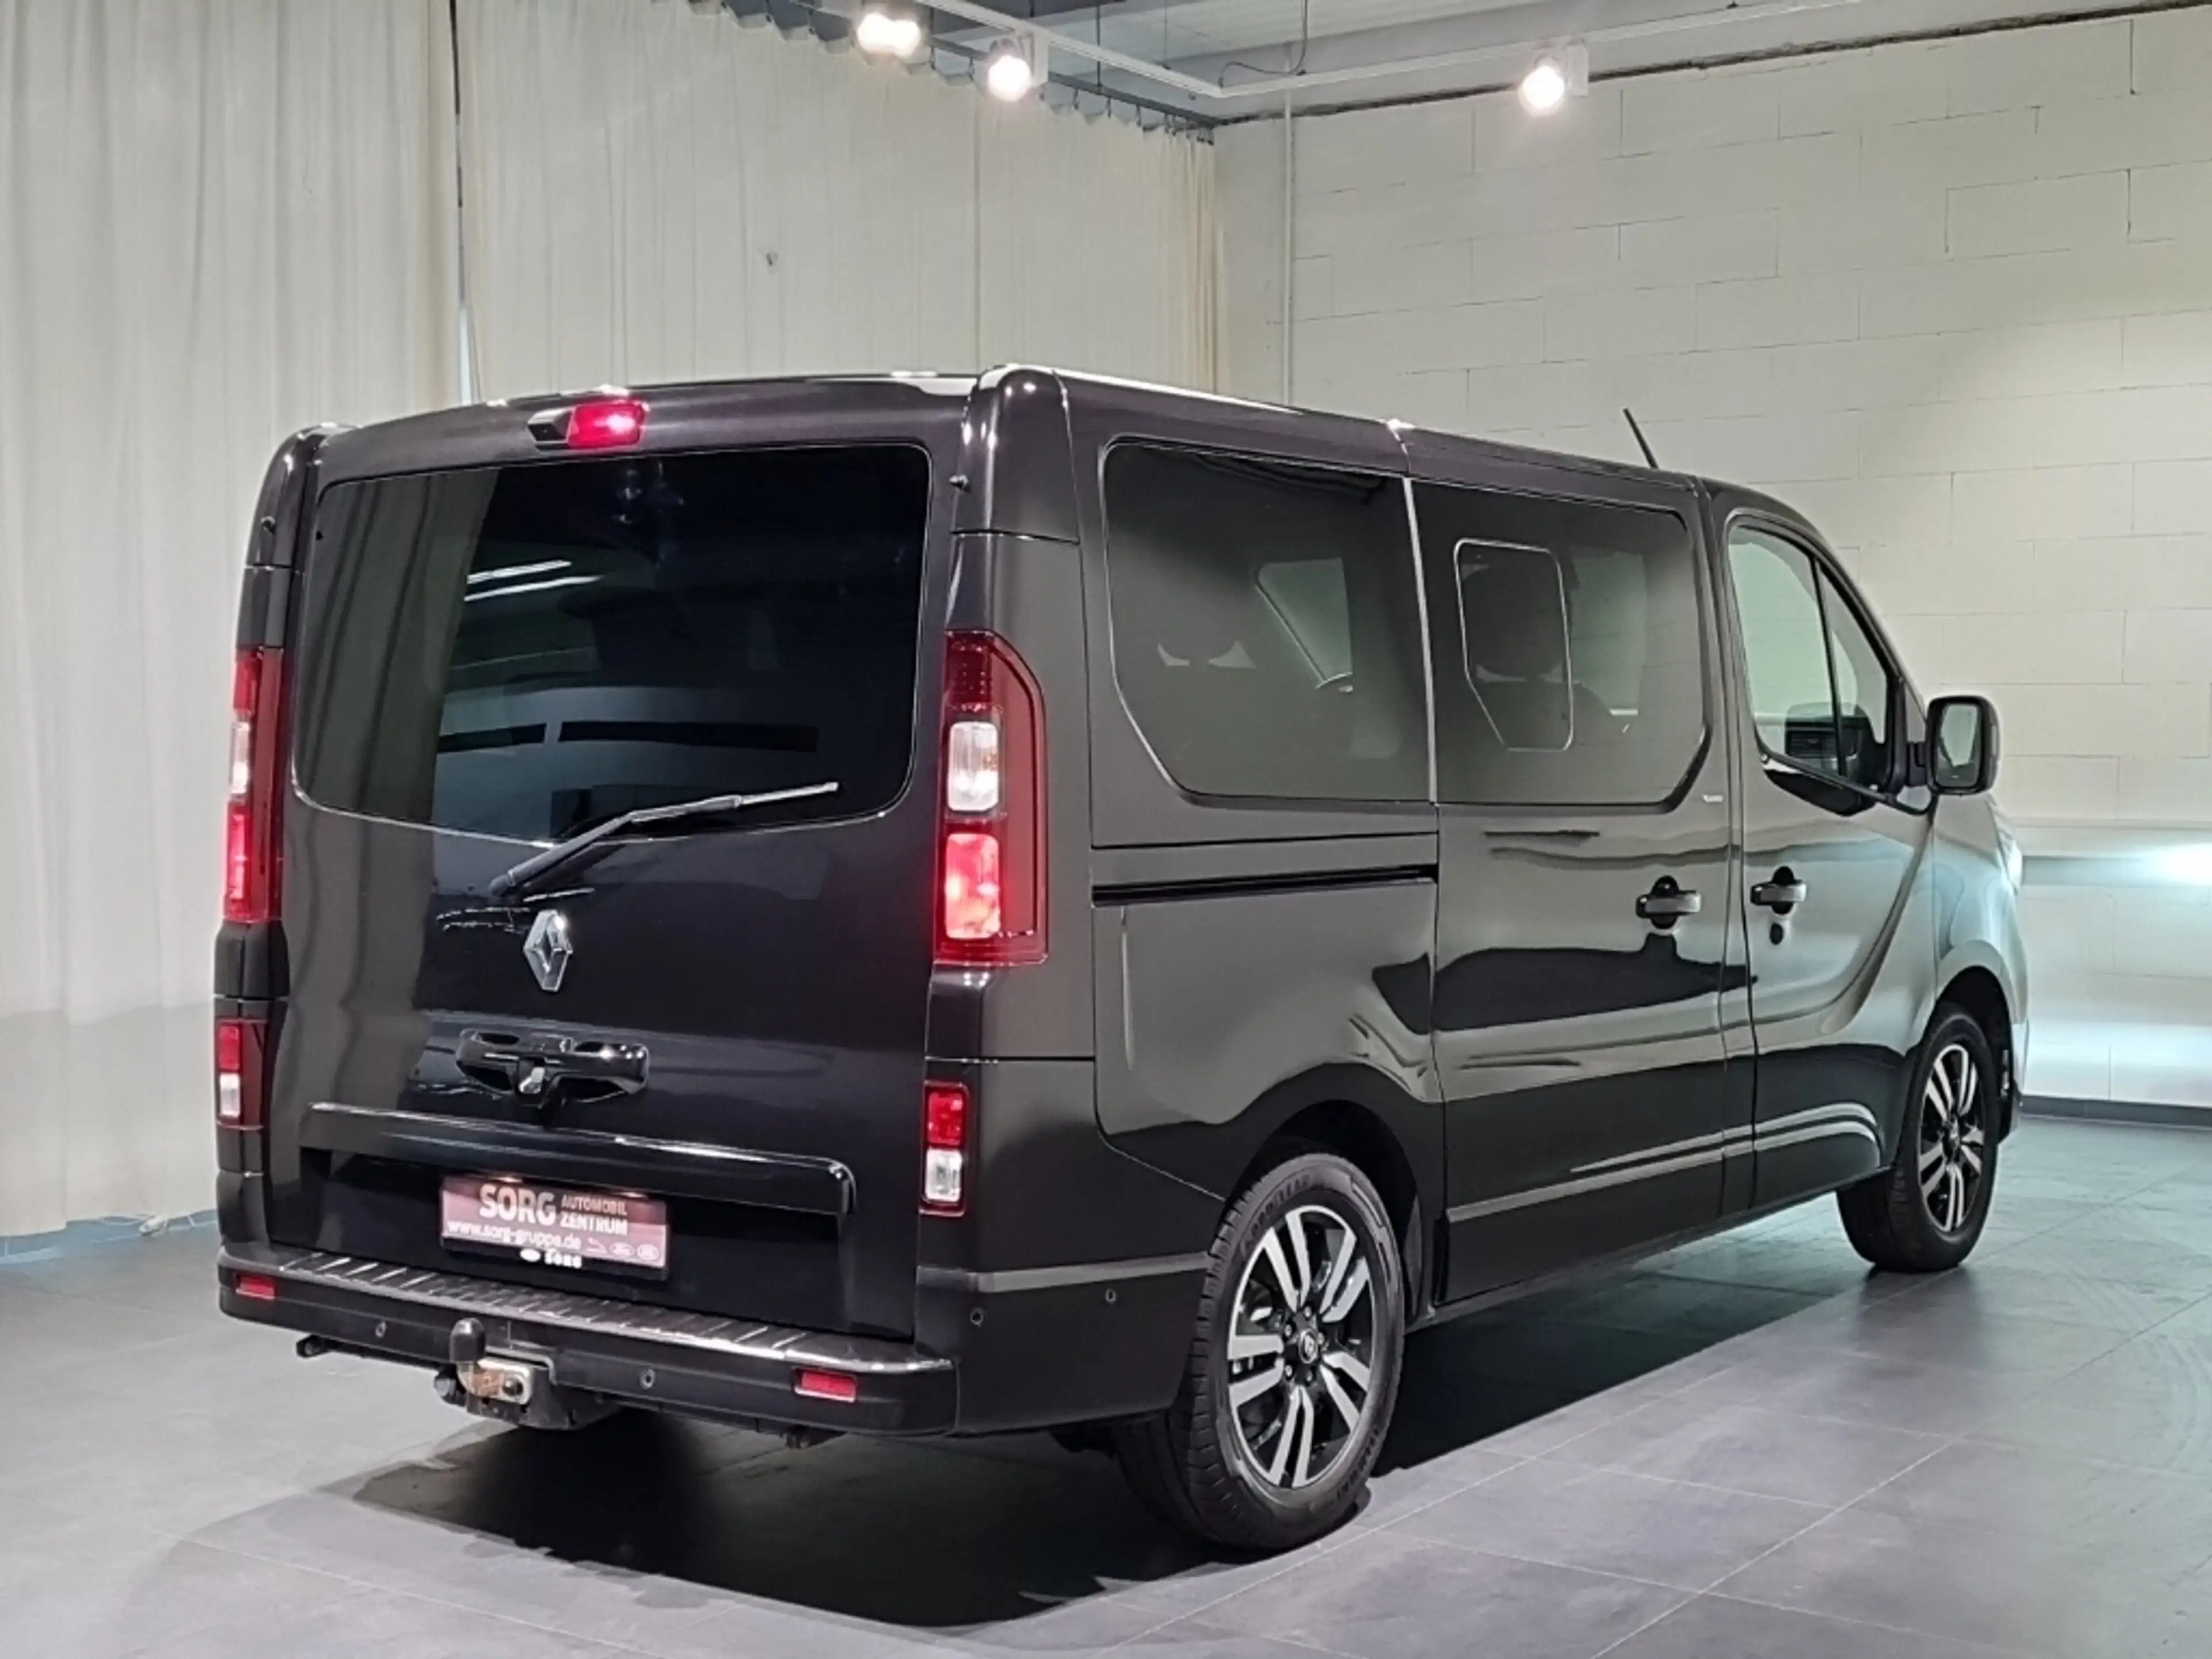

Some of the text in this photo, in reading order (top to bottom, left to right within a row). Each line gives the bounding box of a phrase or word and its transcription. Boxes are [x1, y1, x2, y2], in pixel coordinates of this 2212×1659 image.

[480, 1183, 556, 1225] SORG
[561, 1194, 627, 1215] AUTOMOBIL
[447, 1220, 582, 1251] www.sorg-gruppe.de
[560, 1213, 628, 1235] ZENTRUM
